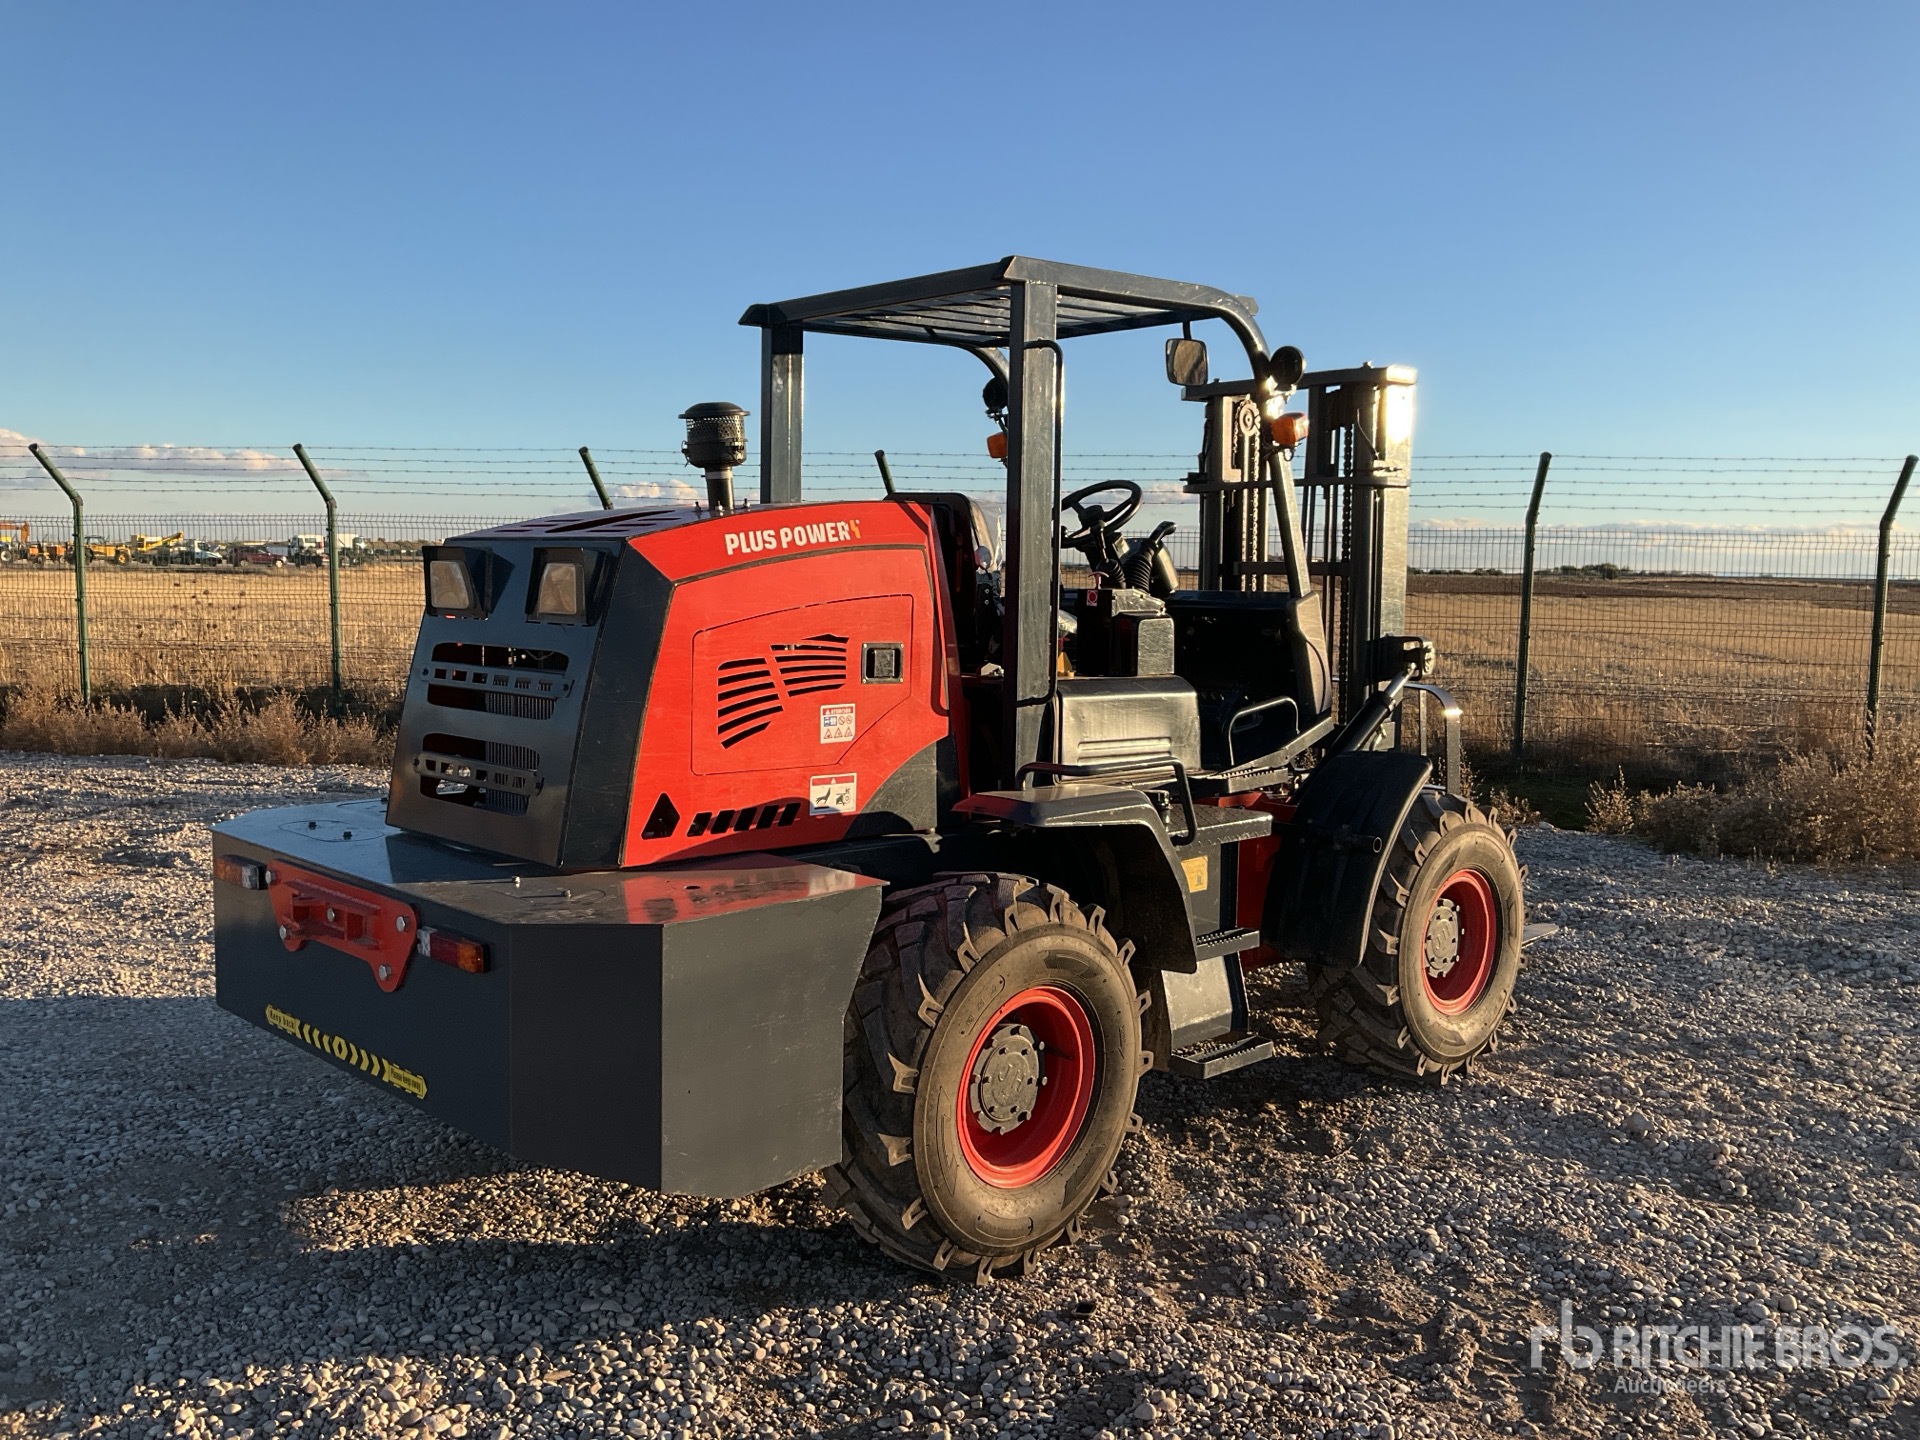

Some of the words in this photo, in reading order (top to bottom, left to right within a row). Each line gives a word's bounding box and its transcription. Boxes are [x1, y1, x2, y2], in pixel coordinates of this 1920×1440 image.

[724, 529, 777, 555] PLUS
[779, 520, 851, 548] POWER
[269, 1009, 281, 1024] Keep
[282, 1016, 294, 1030] back
